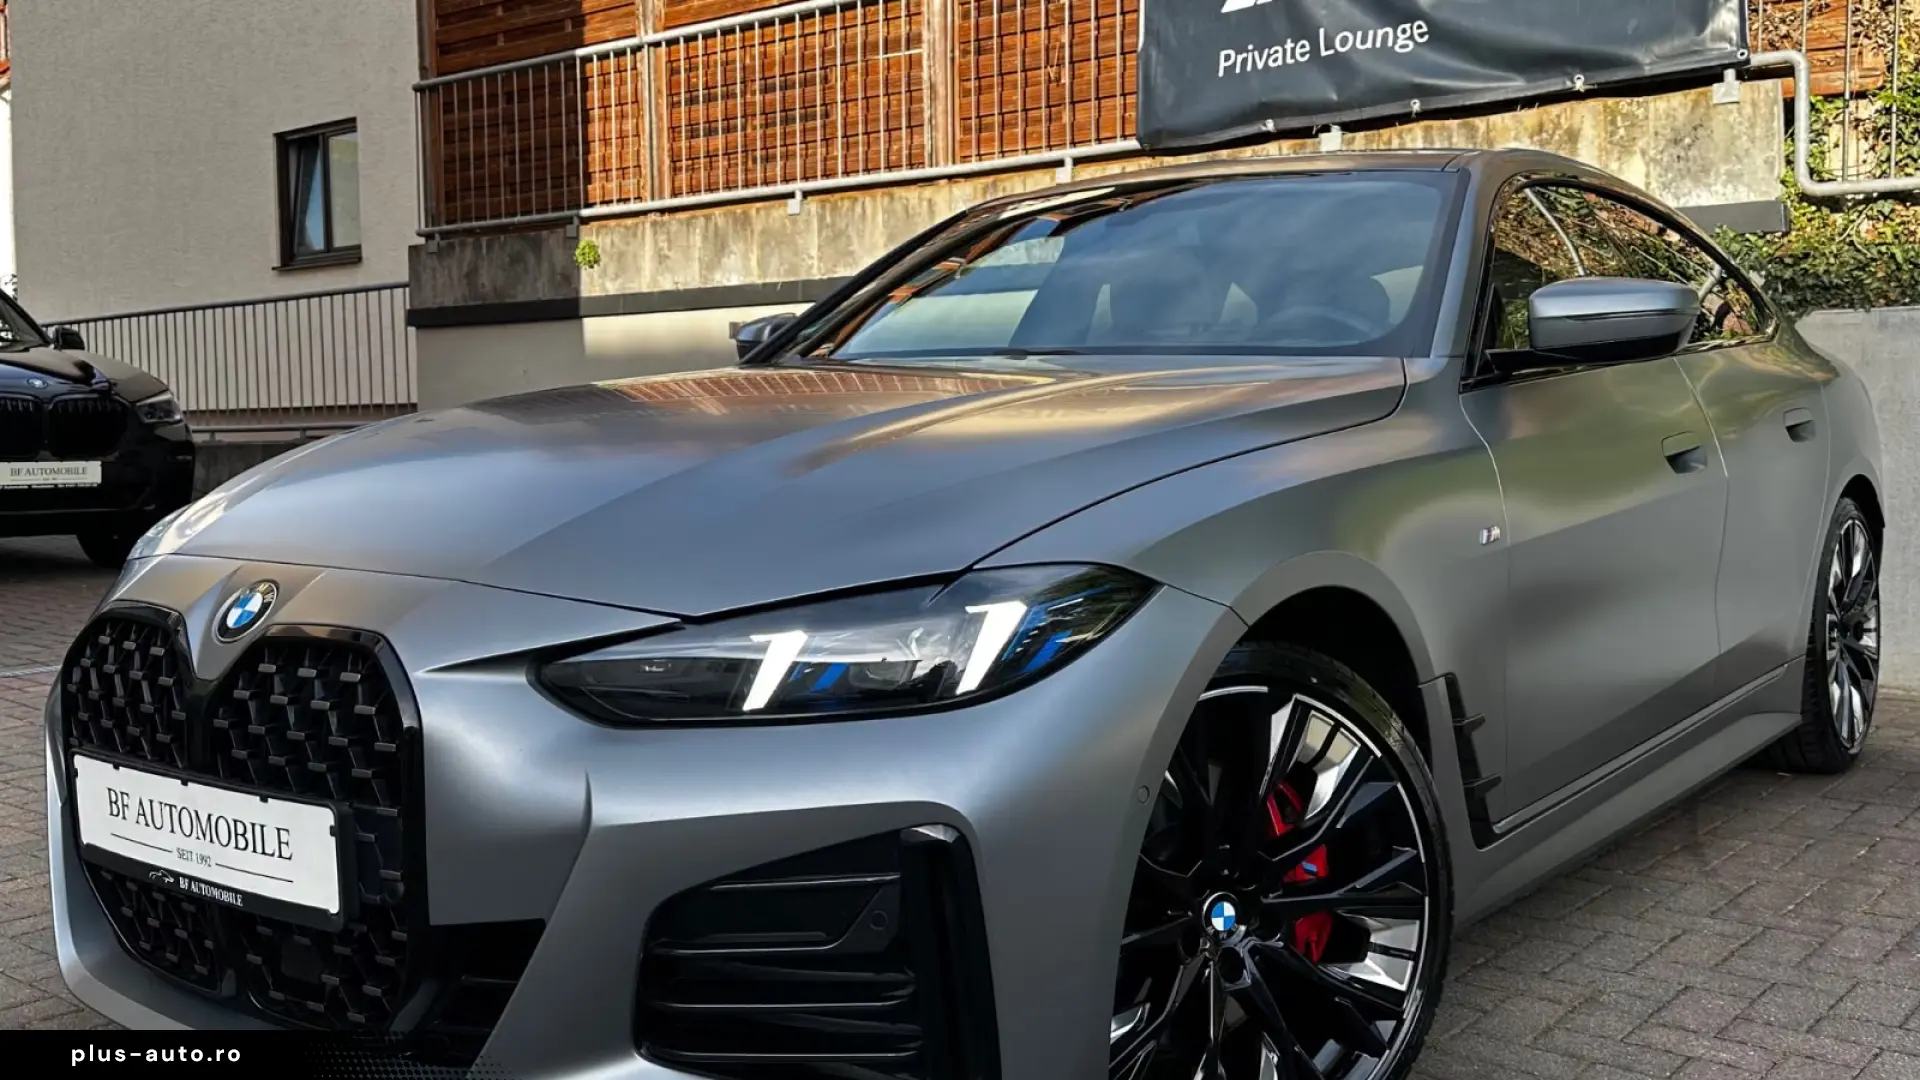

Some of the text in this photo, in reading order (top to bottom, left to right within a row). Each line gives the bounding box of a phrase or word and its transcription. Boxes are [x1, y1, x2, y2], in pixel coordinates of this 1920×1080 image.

[1218, 19, 1430, 78] Private Lounge
[107, 787, 293, 861] BF AUTOMOBILE
[176, 847, 212, 868] SEIT 1992
[179, 876, 244, 907] BF AUTOMOBILE
